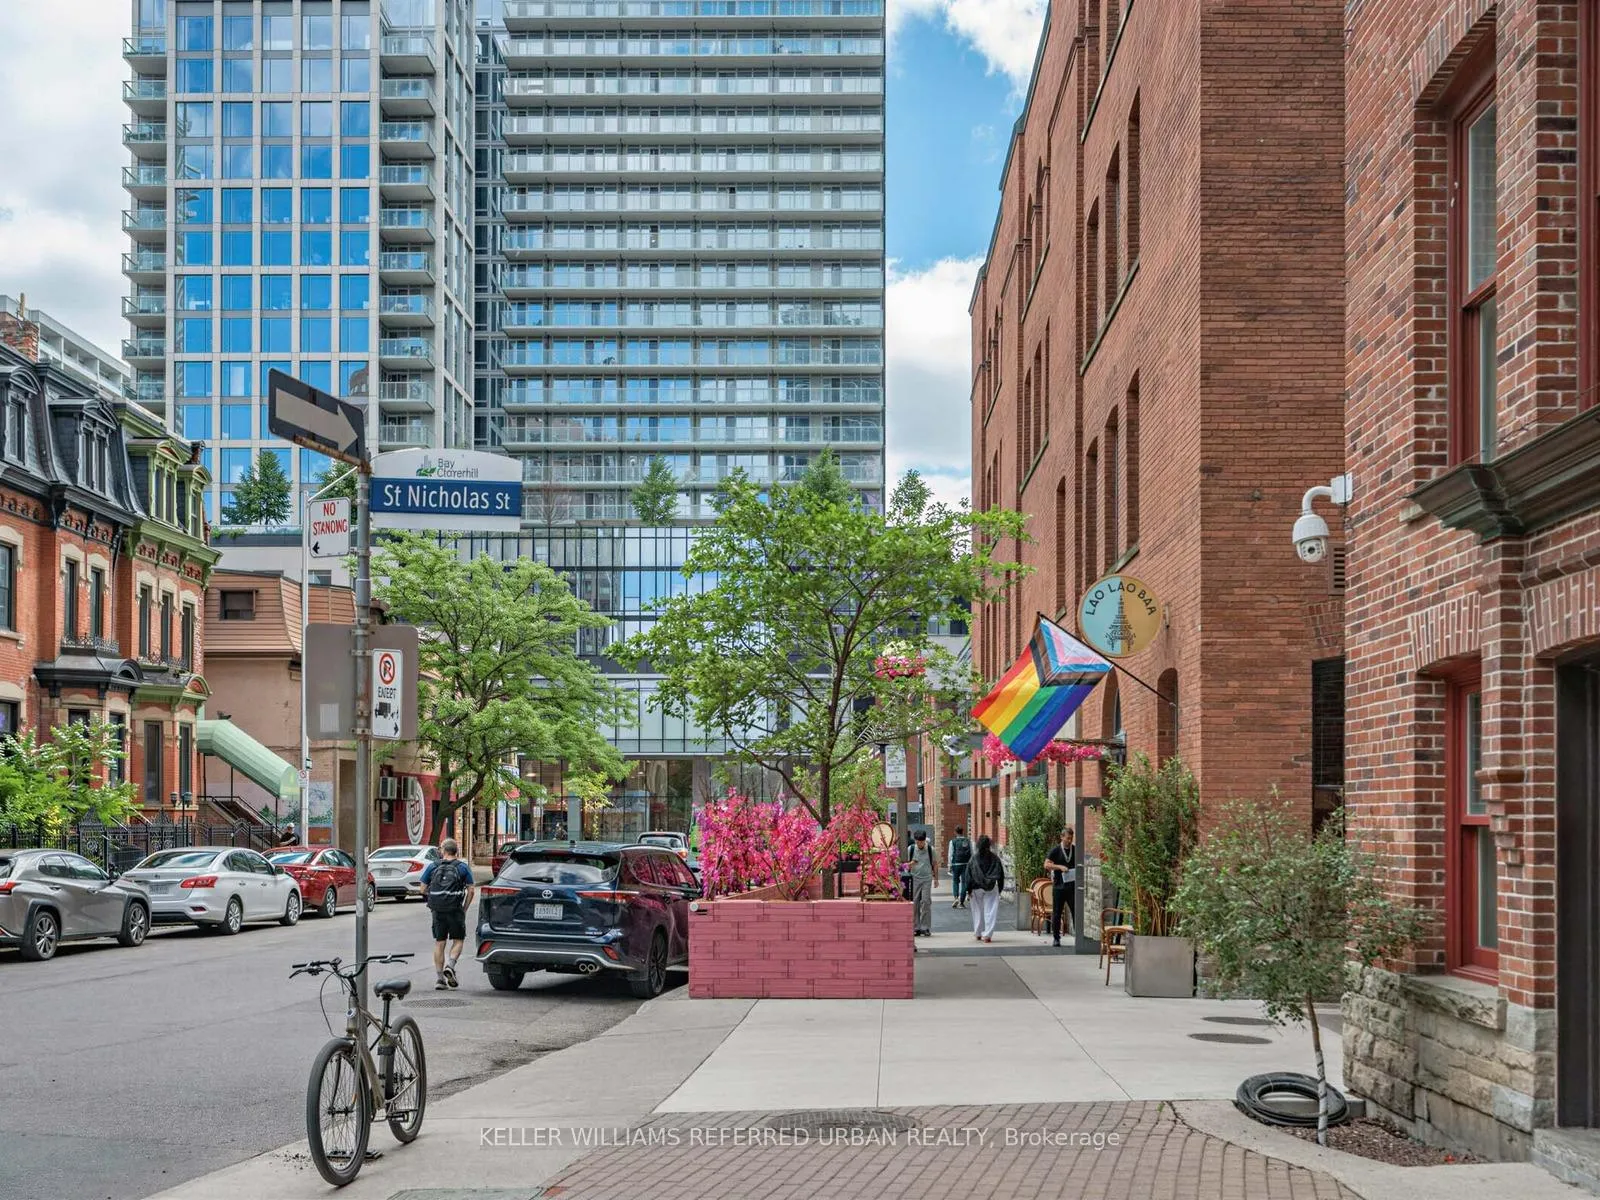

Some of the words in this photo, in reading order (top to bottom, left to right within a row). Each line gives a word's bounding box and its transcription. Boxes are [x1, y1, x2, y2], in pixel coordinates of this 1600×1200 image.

[437, 458, 455, 469] Bay
[383, 484, 401, 507] St
[407, 485, 489, 509] Nicholas
[495, 492, 510, 510] St
[323, 502, 336, 516] NO
[312, 519, 348, 536] STANDING
[1085, 590, 1105, 616] LAO
[1107, 581, 1136, 593] LAO
[1137, 589, 1157, 616] BAA
